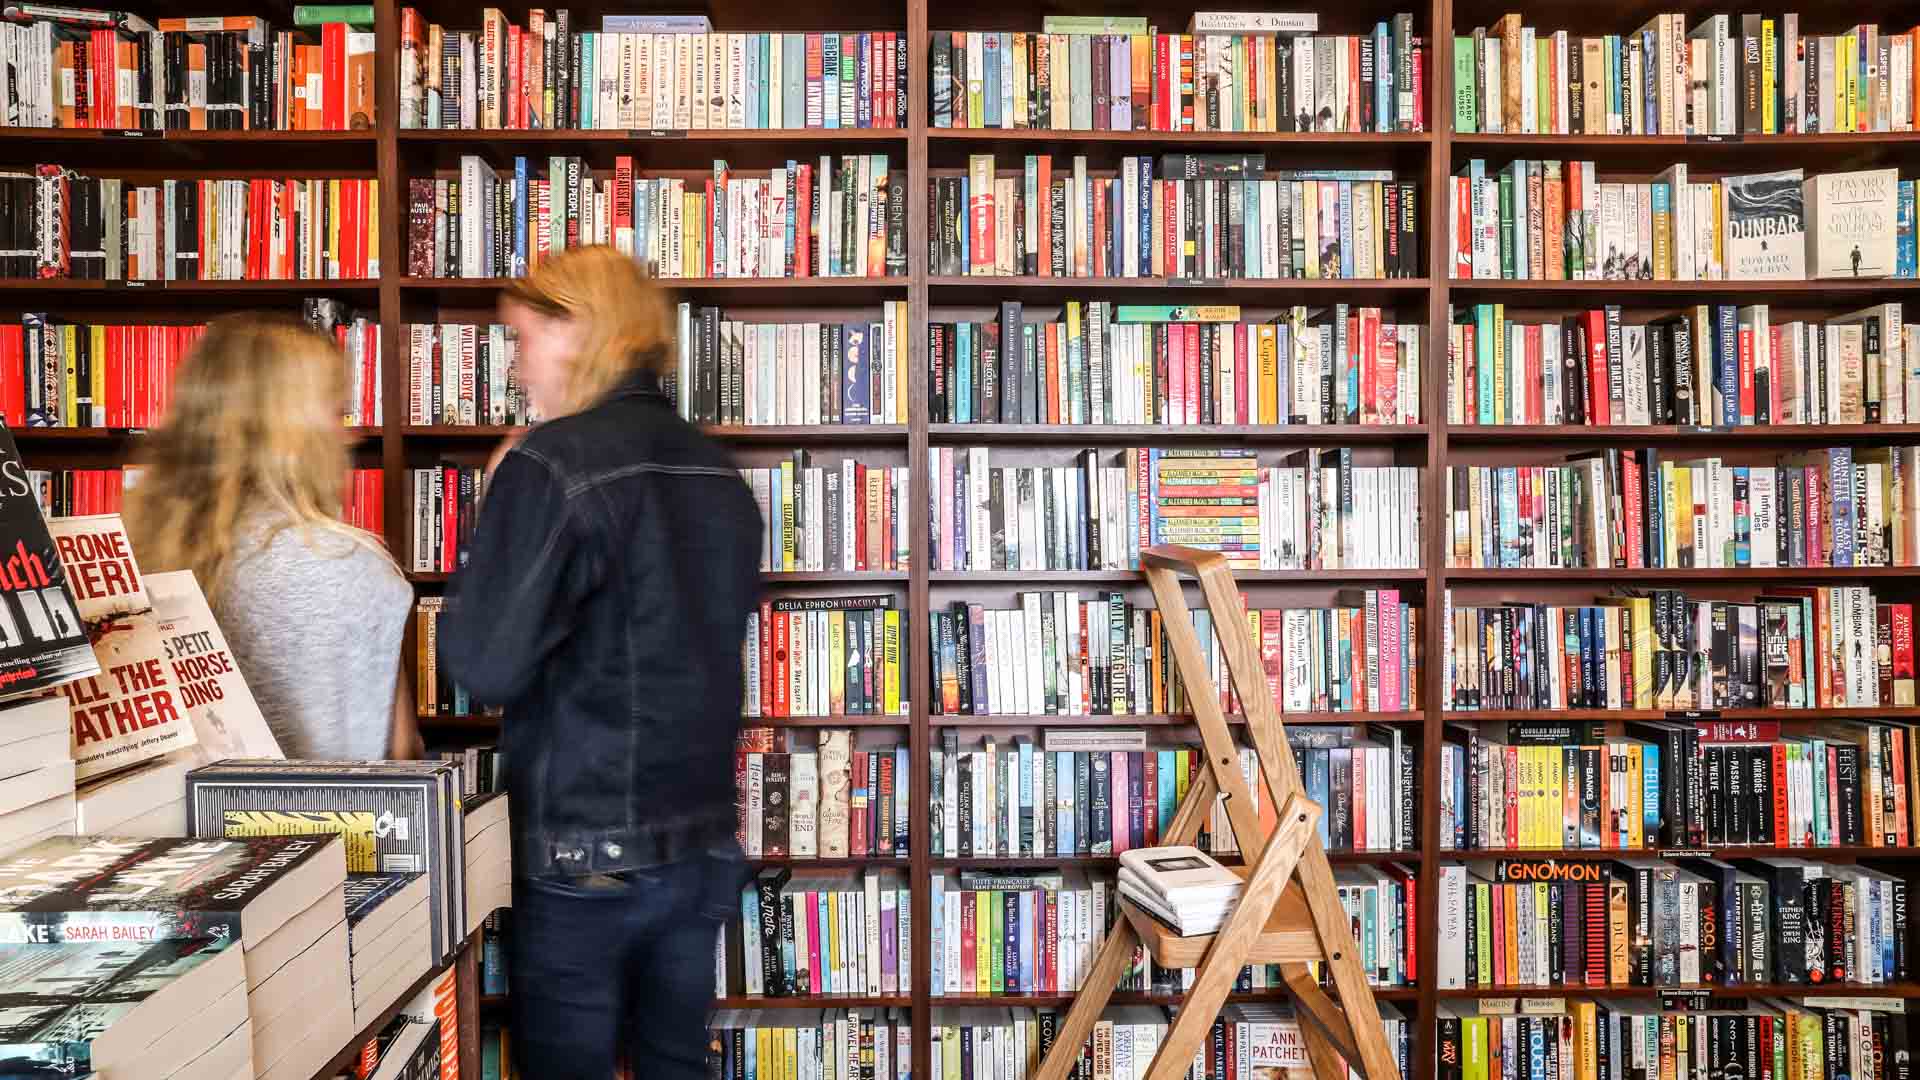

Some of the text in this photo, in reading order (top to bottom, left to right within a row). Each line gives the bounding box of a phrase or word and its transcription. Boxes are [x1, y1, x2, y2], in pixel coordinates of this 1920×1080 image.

[487, 66, 495, 91] ARAVIND
[825, 50, 838, 76] CRAKE
[1362, 43, 1372, 82] JACOBSON
[1879, 48, 1887, 101] JASPER JONES
[1623, 82, 1630, 90] of
[568, 164, 578, 218] GOOD PEOPLE
[1142, 163, 1150, 184] Rachel
[503, 184, 511, 210] MURRAY
[617, 168, 630, 216] GREATEST HITS
[892, 186, 902, 227] ORIENT
[1142, 185, 1150, 209] Joyce
[539, 185, 551, 251] IAIN BANKS
[1729, 214, 1799, 239] DUNBAR
[1141, 242, 1149, 258] Shop
[1281, 228, 1289, 251] KENT
[462, 328, 474, 370] WILLIAM
[1262, 339, 1273, 376] Capital
[1322, 334, 1330, 348] the
[1608, 311, 1622, 398] MY ABSOLUTE DARLING
[984, 350, 994, 398] Historian
[1322, 351, 1330, 371] boat
[1724, 311, 1735, 412] PAUL THEROUX MOTHER LAND
[1322, 404, 1330, 413] le
[0, 461, 29, 497] S
[1792, 479, 1800, 501] Sarah
[1833, 456, 1841, 501] WALTERS
[1841, 456, 1849, 500] MINETTE
[1761, 495, 1770, 528] Infinite
[1810, 475, 1819, 526] Sarah Waters
[784, 503, 792, 553] ELIZABETH DAY
[1754, 512, 1762, 531] Jest
[1835, 519, 1843, 555] HOURS
[56, 532, 128, 564] RONE
[66, 560, 140, 600] IERI
[778, 600, 838, 610] DELIA EPHRON
[1851, 589, 1863, 637] COLOMBIANO
[173, 631, 216, 657] PETIT
[887, 625, 897, 664] VIPER WINE
[1112, 594, 1125, 702] EMILY MAGUIRE
[1896, 614, 1904, 651] ZUSAK
[45, 676, 108, 706] ILL
[110, 658, 167, 694] THE
[171, 652, 233, 684] HORSE
[180, 679, 224, 709] DING
[70, 690, 179, 746] ATHER
[880, 758, 892, 794] CANADA
[1710, 761, 1718, 791] TWELVE
[1730, 761, 1739, 795] PASSAGE
[1753, 758, 1762, 793] MIRRORS
[1839, 748, 1851, 783] FEIST
[1402, 767, 1413, 829] Night Circus
[1644, 767, 1656, 816] FELLSIDE
[213, 866, 267, 900] SARAH
[269, 840, 319, 872] BAILEY
[1508, 863, 1600, 881] GNOMON
[1832, 882, 1843, 956] NEVERNIGHT
[1895, 885, 1905, 921] LUNA
[65, 926, 107, 940] SARAH
[112, 926, 155, 940] BAILEY
[1613, 921, 1624, 961] DUNE
[1704, 906, 1715, 953] WOOL
[1752, 932, 1764, 959] WORLD
[848, 1017, 858, 1051] GRAVEL
[1271, 1032, 1296, 1044] ANN
[1661, 1018, 1672, 1055] PRATCHETT
[1729, 1020, 1738, 1062] 2312
[1747, 1018, 1755, 1028] KIM
[1115, 1031, 1123, 1067] PAMUK
[1123, 1031, 1131, 1068] ORHAN
